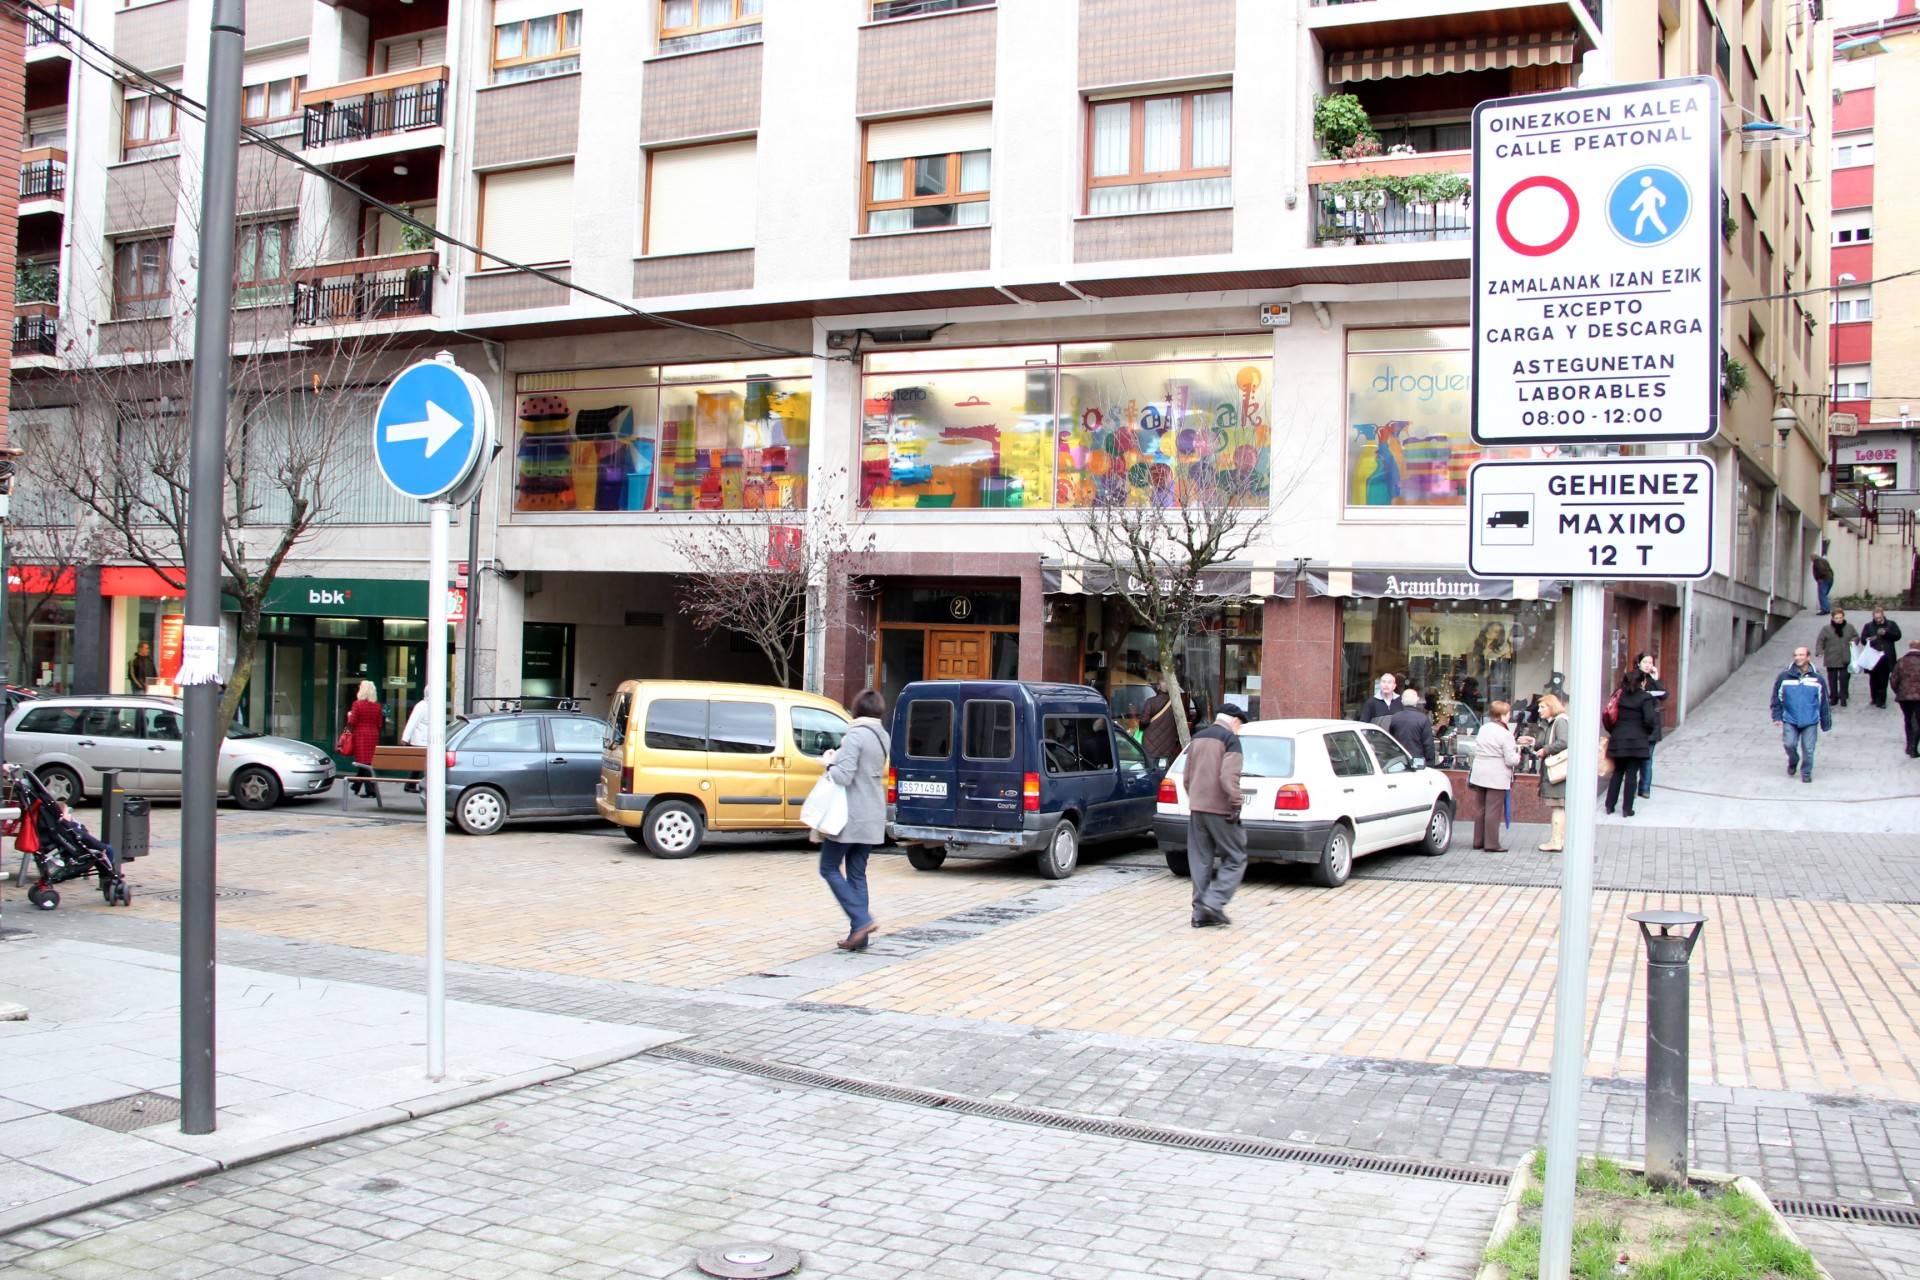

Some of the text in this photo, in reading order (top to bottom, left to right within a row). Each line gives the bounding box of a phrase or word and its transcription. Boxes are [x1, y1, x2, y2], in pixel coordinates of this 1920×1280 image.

[1490, 97, 1698, 133] OINEZKOEN KALEA
[1495, 126, 1693, 158] CALLE PEATONAL
[1488, 268, 1702, 295] ZAMALANAK IZAN EZIK
[1543, 299, 1642, 319] EXCEPTO
[1486, 318, 1703, 343] CARGA Y DESCARGA
[1512, 354, 1675, 375] ASTEGUNETAN
[1518, 382, 1667, 402] LABORABLES
[1522, 409, 1585, 426] 08:00
[1603, 407, 1663, 424] 12:00
[1854, 448, 1897, 461] LOOK
[1548, 473, 1699, 496] GEHIENEZ
[1558, 513, 1686, 534] MAXIMO
[1588, 544, 1653, 566] 12 T
[309, 589, 345, 604] bbk
[1384, 575, 1481, 597] Aramburu
[954, 599, 967, 615] 21
